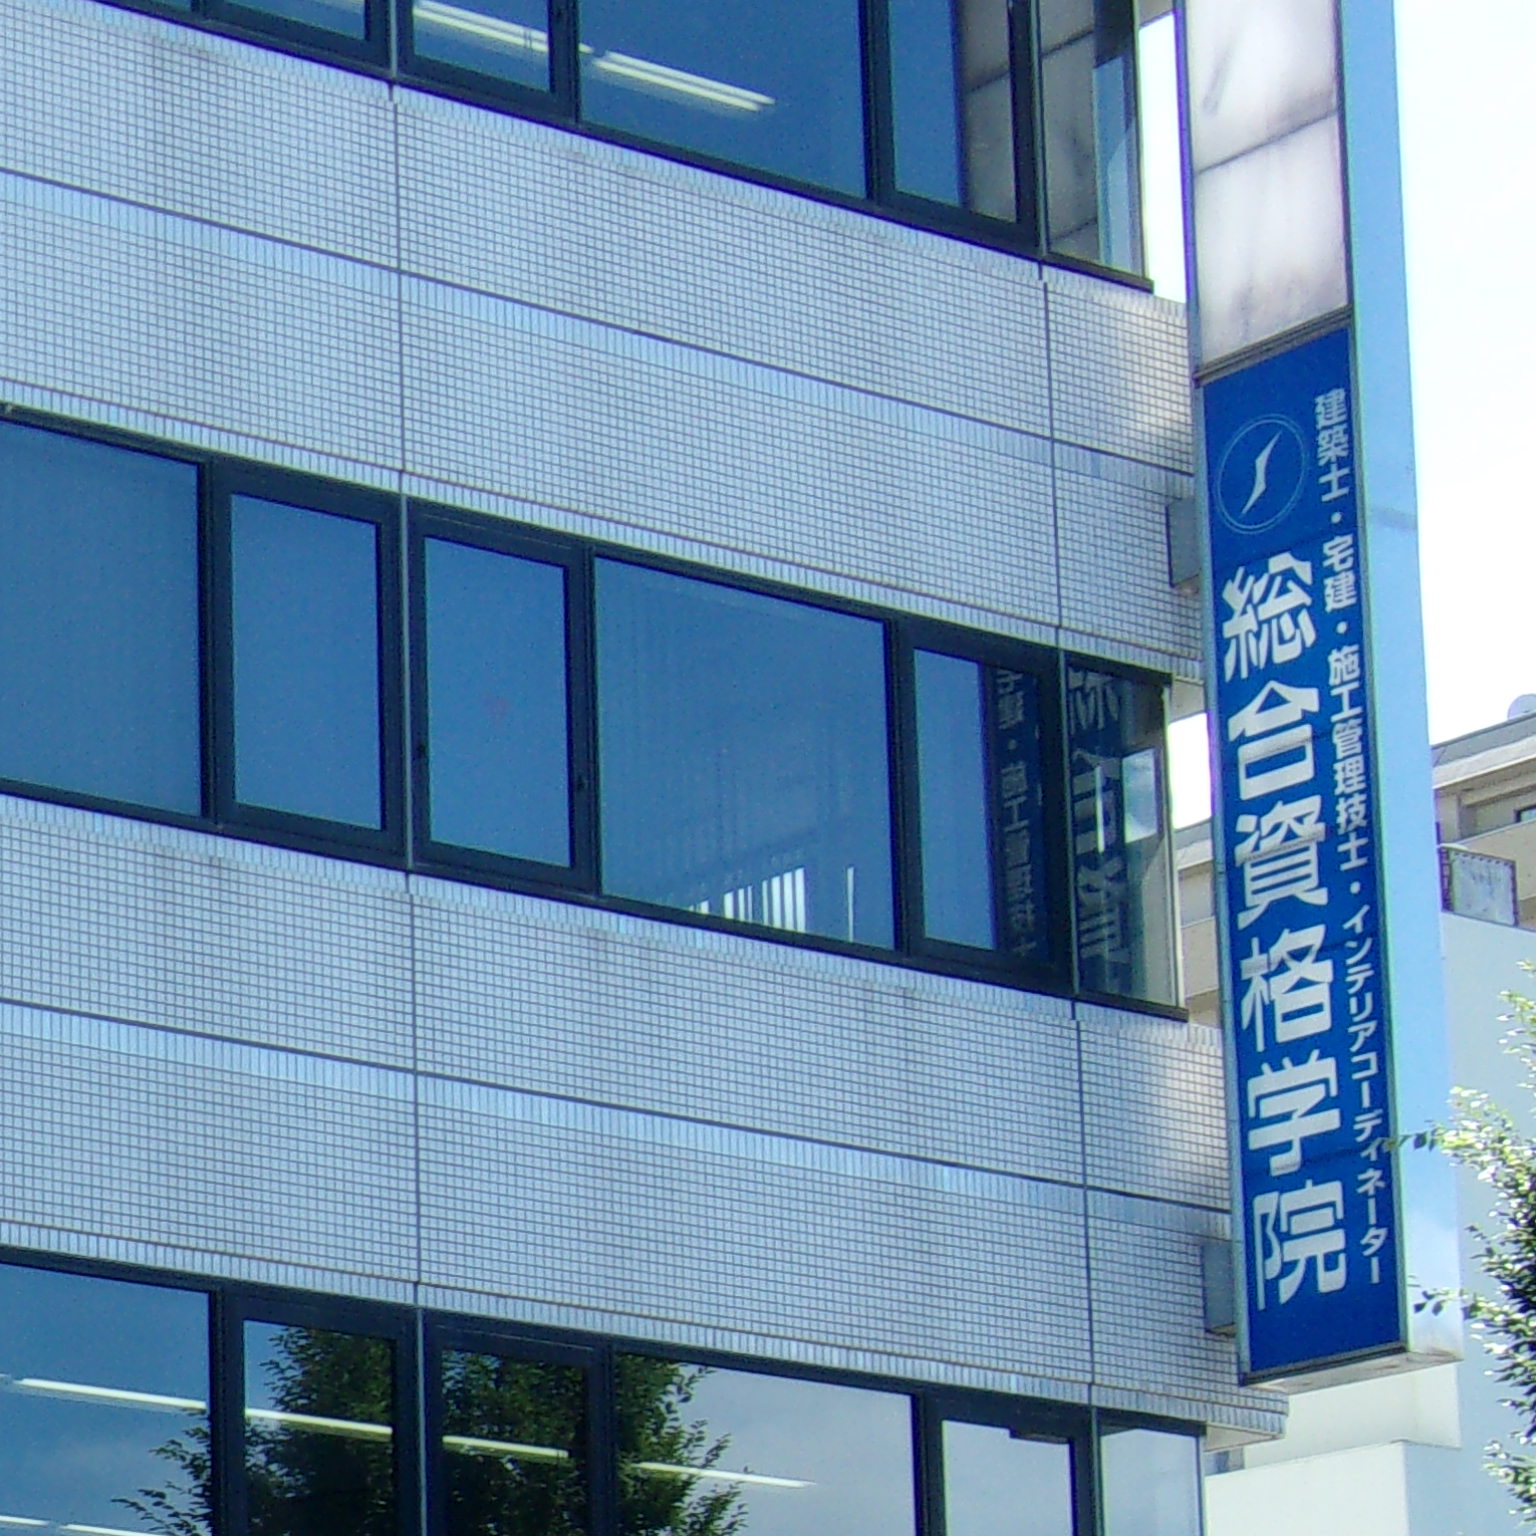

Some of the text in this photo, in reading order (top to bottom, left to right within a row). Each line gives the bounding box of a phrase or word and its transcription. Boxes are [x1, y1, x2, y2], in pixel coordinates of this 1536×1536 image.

[1222, 551, 1347, 1311] 総合資格学院
